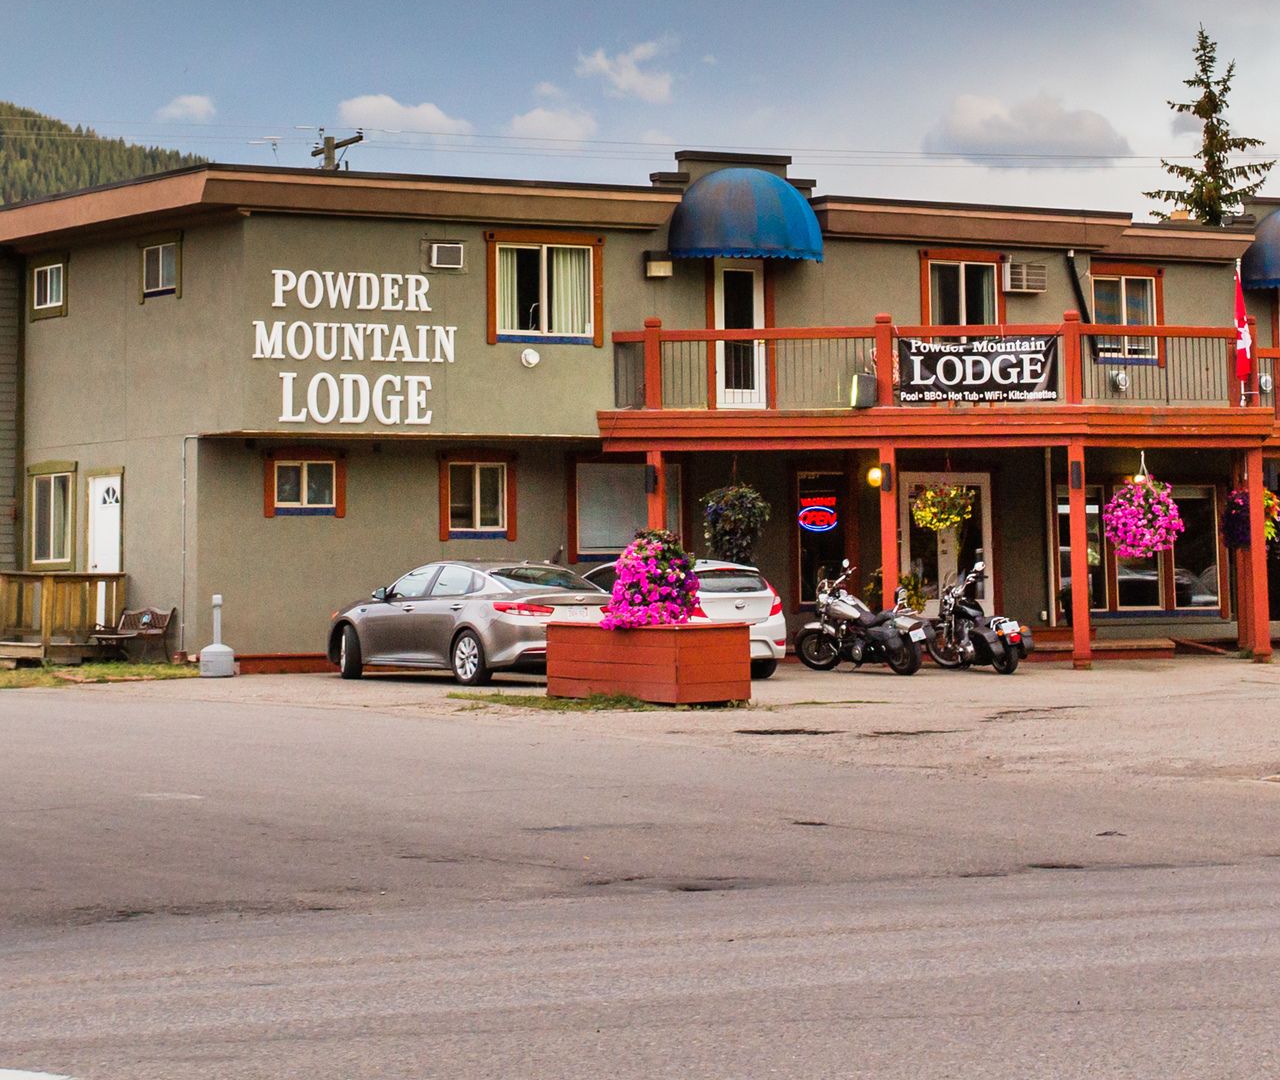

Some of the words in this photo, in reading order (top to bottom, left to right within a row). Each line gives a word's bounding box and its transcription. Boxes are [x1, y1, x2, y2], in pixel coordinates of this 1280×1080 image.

[271, 269, 432, 312] POWDER
[252, 320, 458, 363] MOUNTAIN
[972, 337, 1047, 353] Mountain
[909, 353, 1047, 386] LODGE
[278, 372, 433, 425] LODGE
[900, 391, 919, 401] Pool
[924, 391, 943, 400] BBQ
[948, 391, 963, 400] Hot
[963, 391, 979, 401] Tub
[984, 390, 1003, 400] WiFi
[1008, 390, 1057, 400] Kitchenettes
